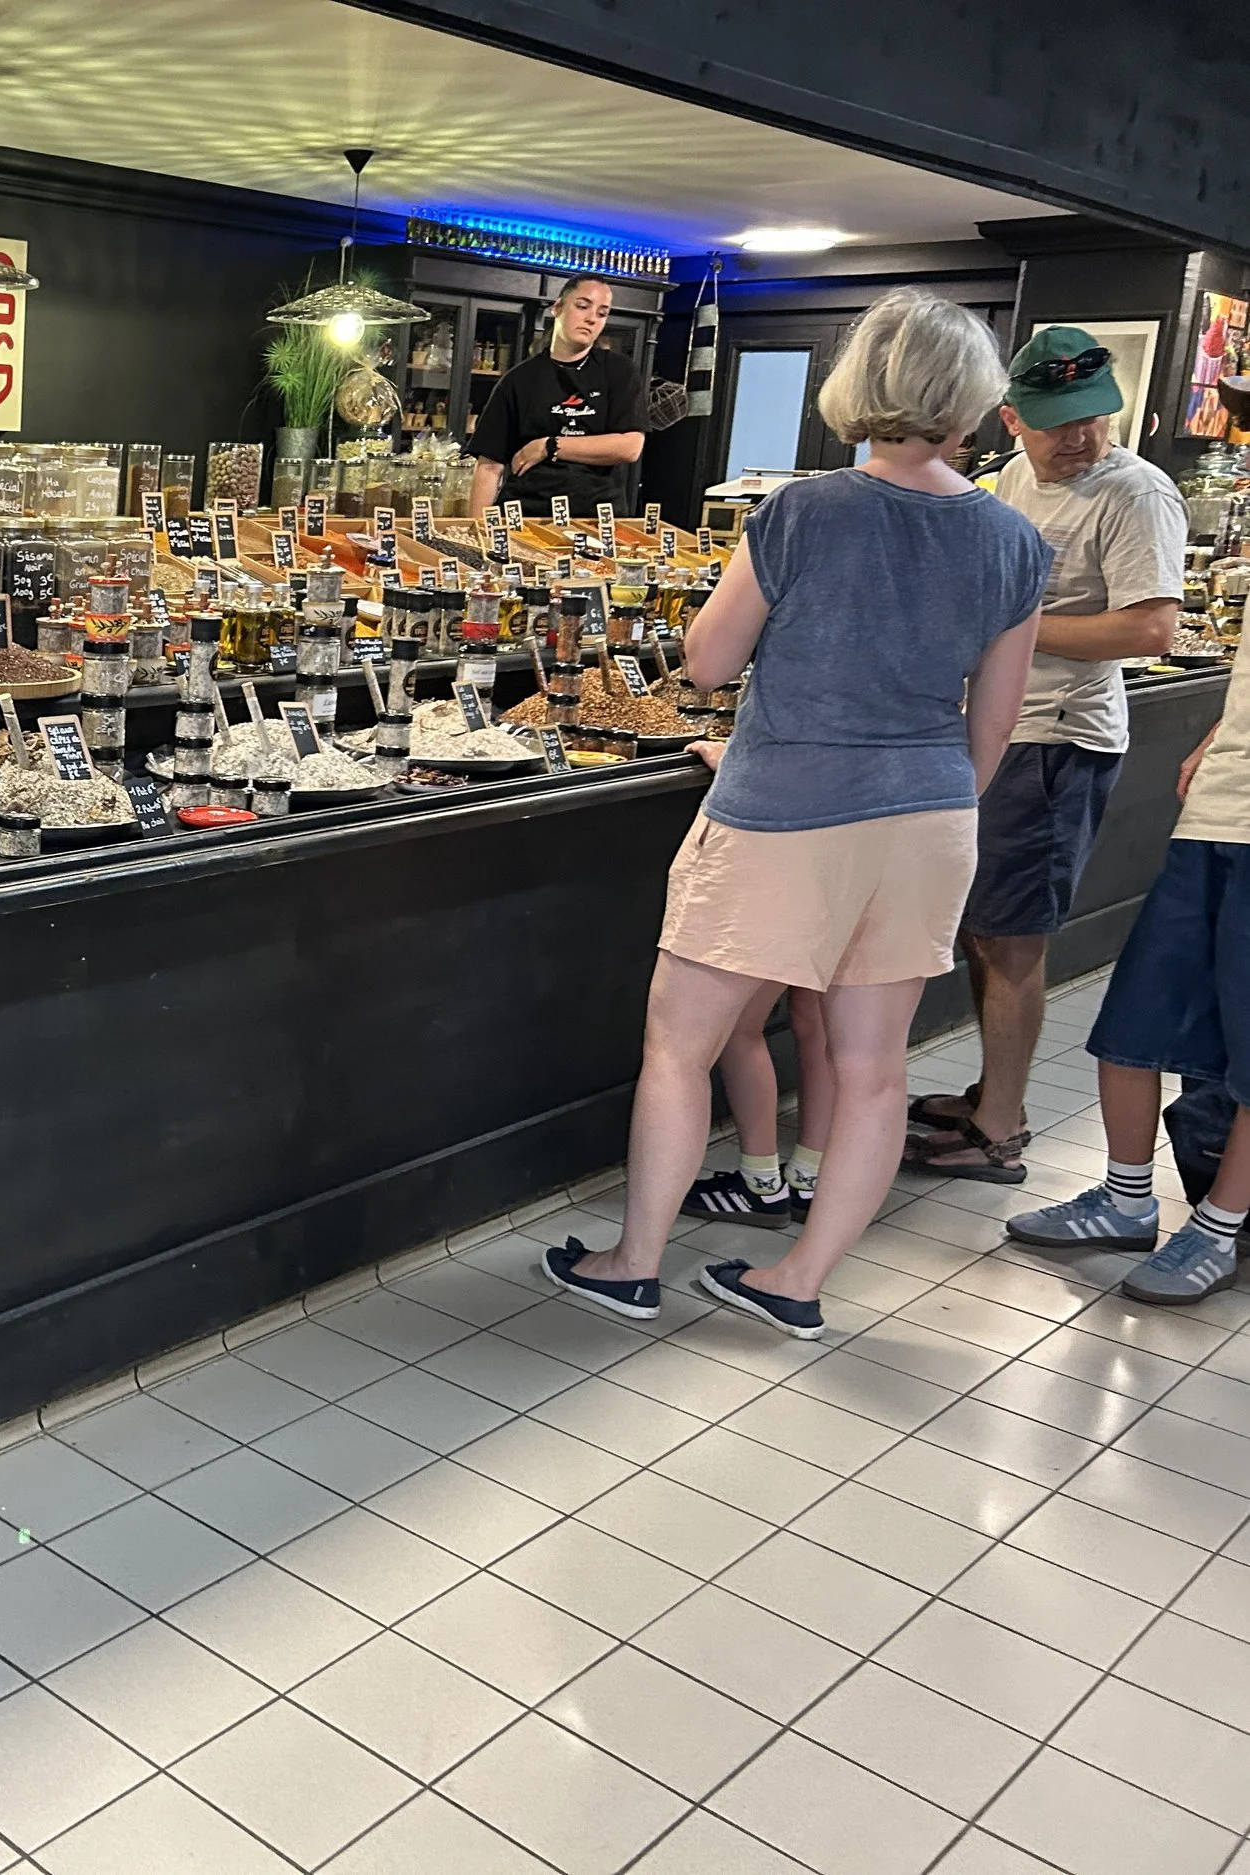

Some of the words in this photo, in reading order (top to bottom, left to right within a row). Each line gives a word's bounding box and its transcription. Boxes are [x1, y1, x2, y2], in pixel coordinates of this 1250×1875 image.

[24, 564, 43, 572] Noir
[13, 575, 32, 588] 50g
[39, 574, 53, 587] 3€
[13, 588, 34, 601] 100g
[39, 587, 53, 600] 5€
